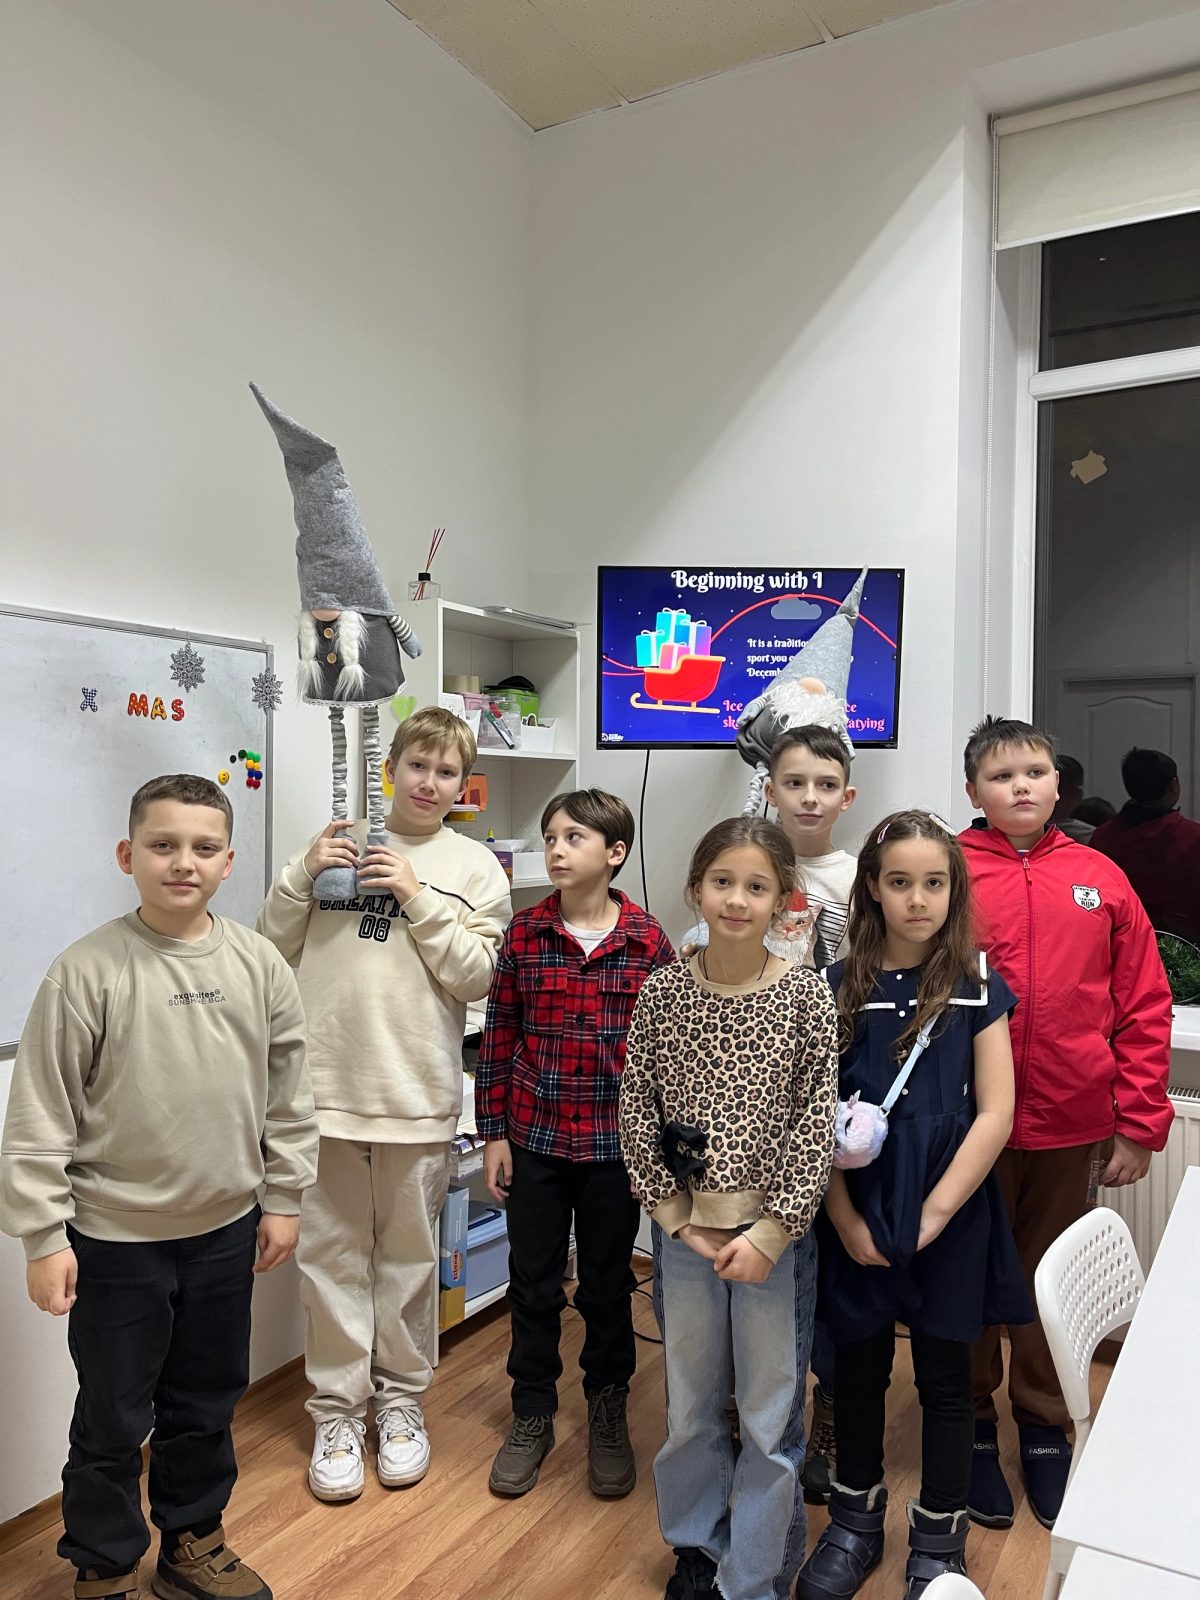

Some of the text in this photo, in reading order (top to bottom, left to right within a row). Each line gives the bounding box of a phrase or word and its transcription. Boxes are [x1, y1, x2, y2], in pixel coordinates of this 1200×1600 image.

[671, 570, 823, 593] Beginning with I
[747, 638, 757, 648] It
[758, 639, 765, 648] is
[774, 638, 808, 648] traditio
[746, 655, 770, 665] sport
[771, 656, 787, 665] you
[80, 687, 185, 721] X MAS
[722, 699, 744, 712] Ice
[358, 914, 391, 943] 08
[1028, 1447, 1060, 1455] FASHION
